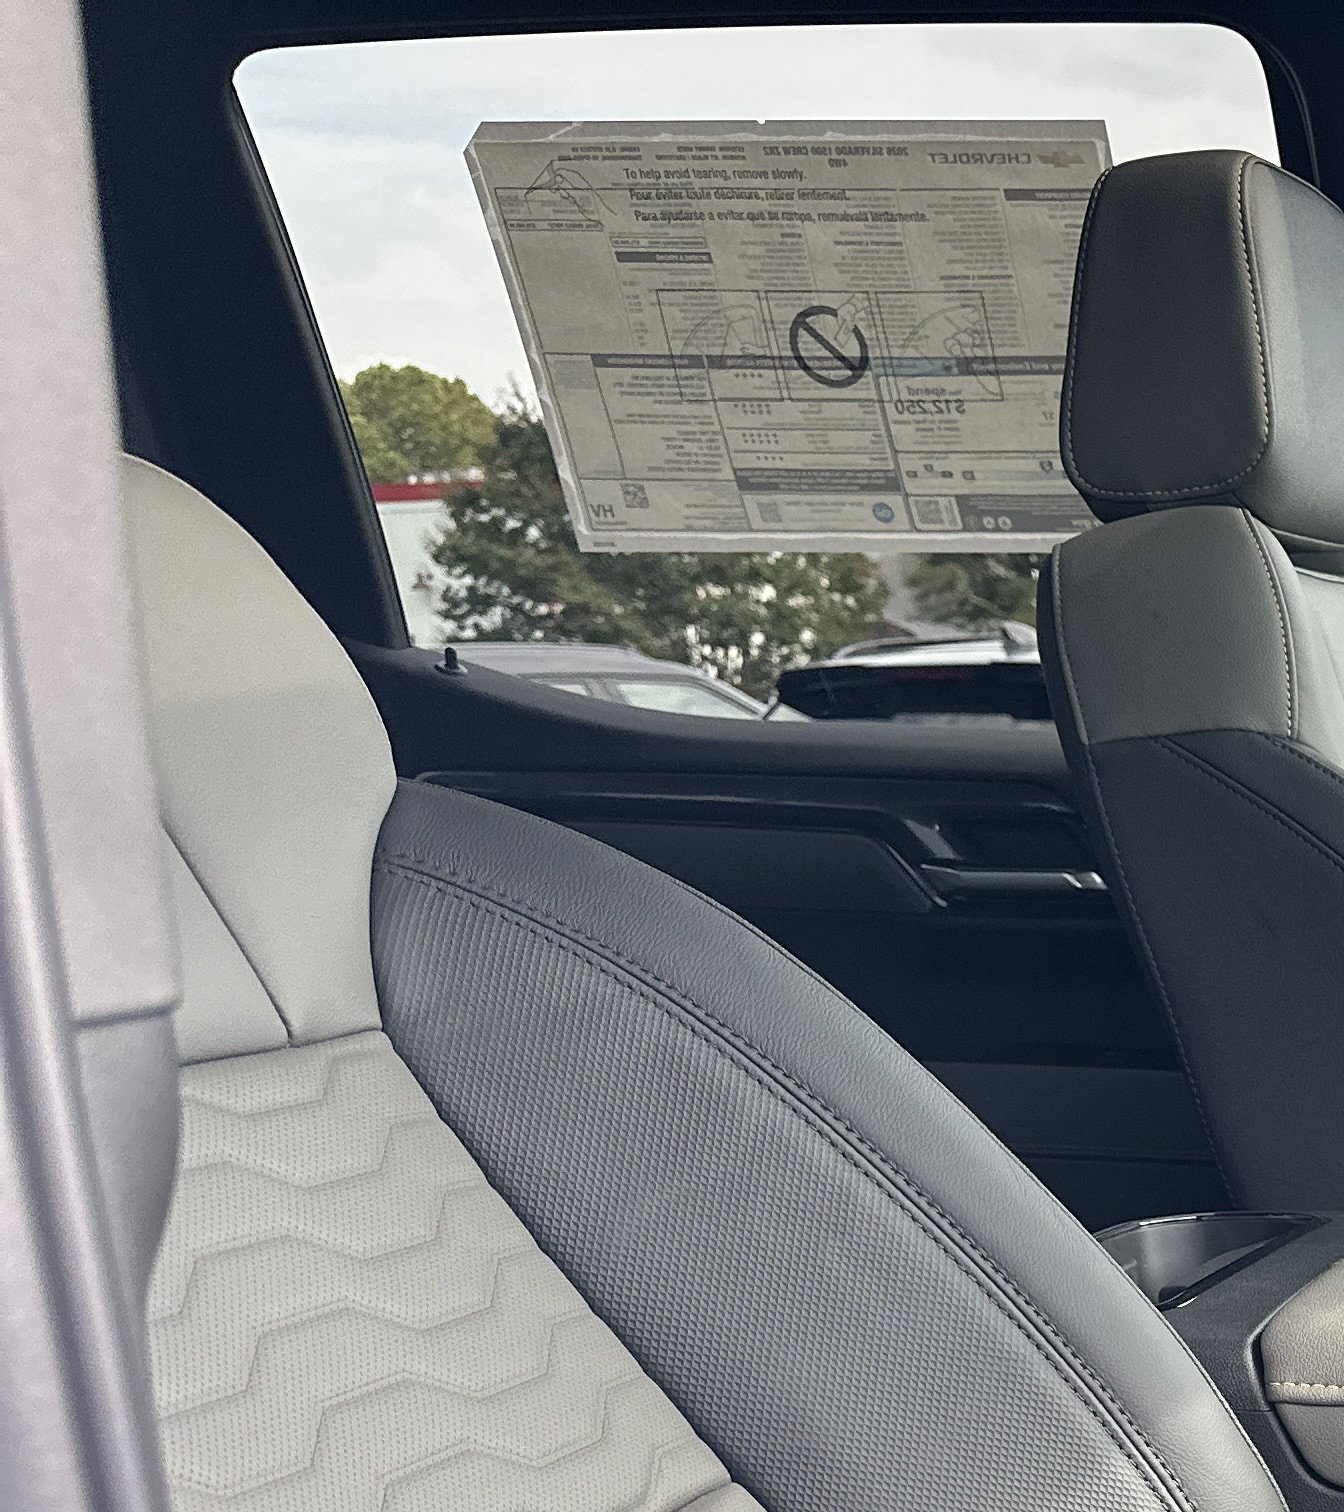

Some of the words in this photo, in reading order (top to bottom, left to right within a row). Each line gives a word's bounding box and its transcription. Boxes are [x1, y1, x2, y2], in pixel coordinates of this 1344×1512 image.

[624, 168, 637, 180] To
[638, 168, 662, 182] help
[664, 168, 691, 180] avoid
[692, 168, 732, 182] tearing,
[733, 169, 770, 180] remove
[771, 168, 808, 182] slowly.
[634, 209, 659, 222] Para
